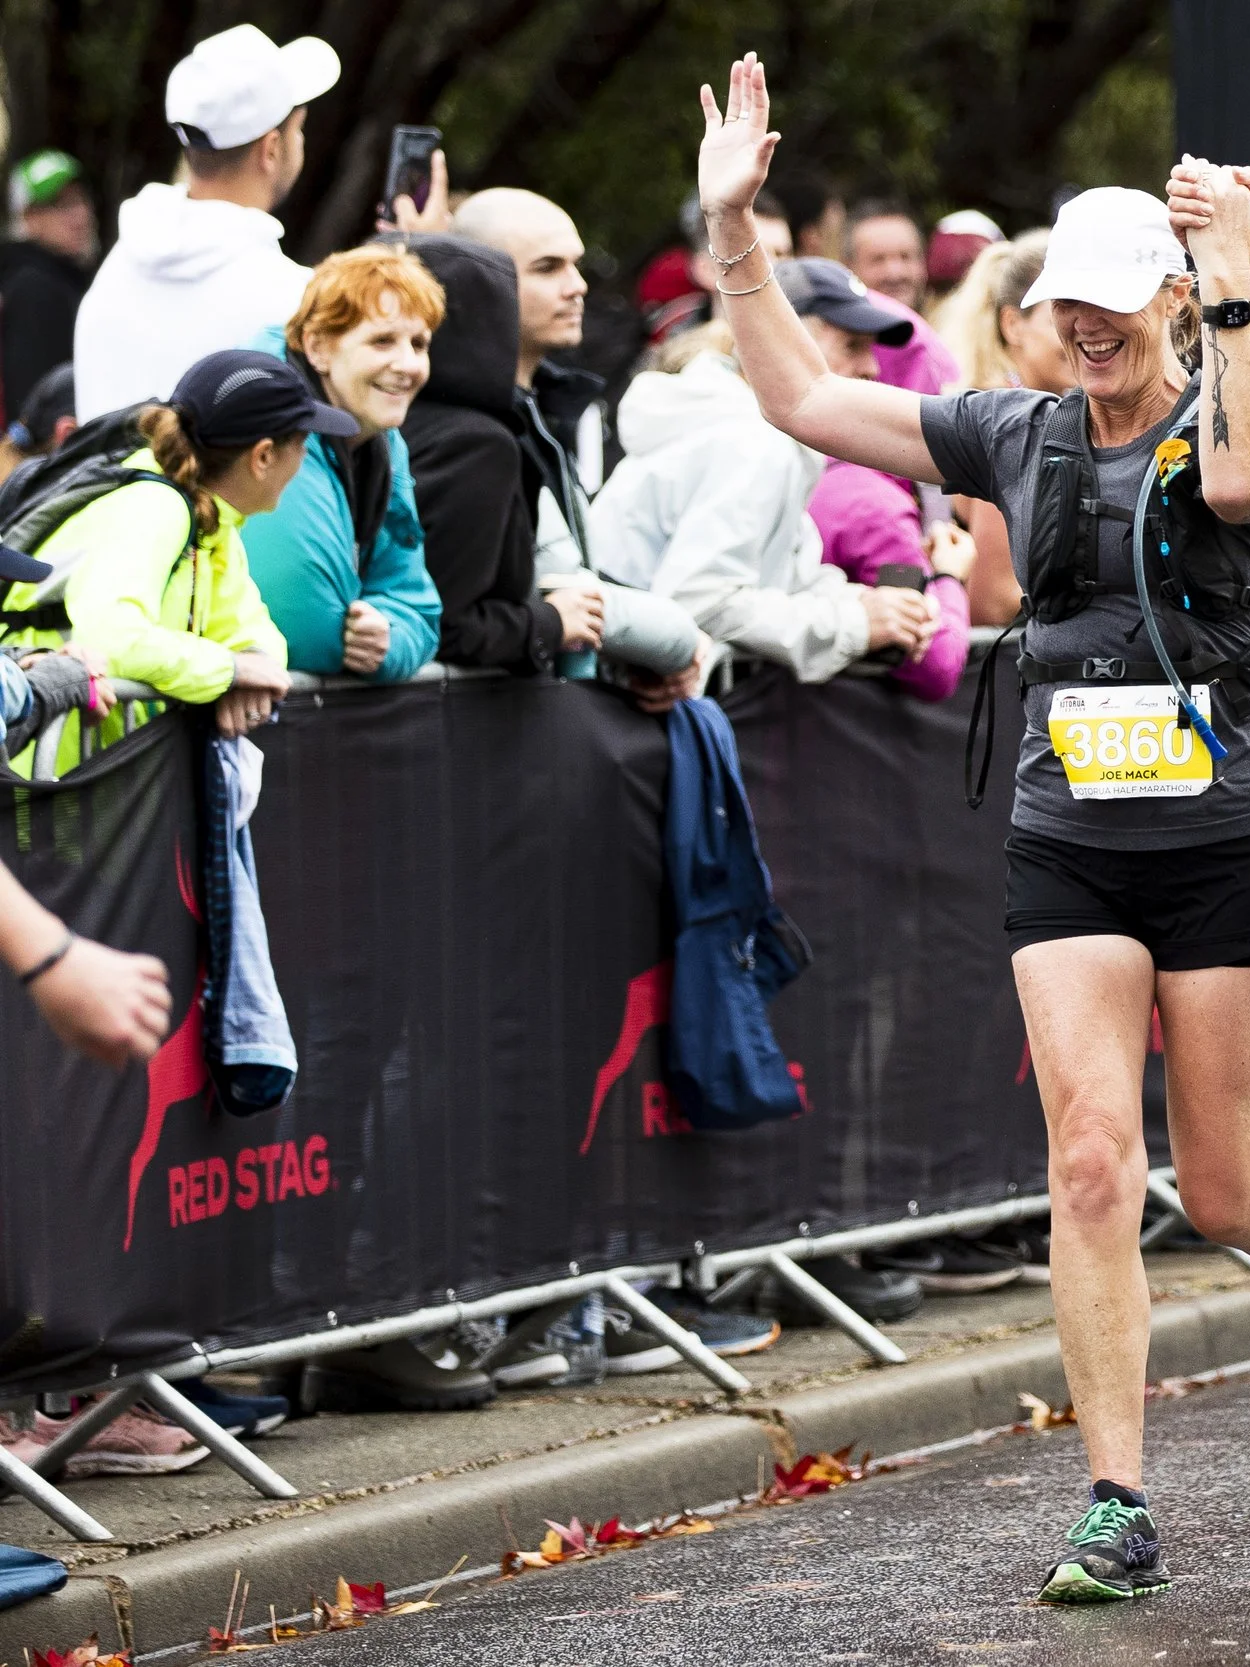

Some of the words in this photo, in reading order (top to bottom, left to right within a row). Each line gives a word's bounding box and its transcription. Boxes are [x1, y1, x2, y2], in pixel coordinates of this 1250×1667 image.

[1168, 696, 1198, 706] NT
[1065, 719, 1194, 769] 3860
[1100, 771, 1122, 780] JOE
[1125, 770, 1158, 780] MACK
[1073, 786, 1112, 796] ROTORUA
[1113, 786, 1137, 794] HALF
[1139, 784, 1193, 793] MARATHON
[168, 1156, 230, 1228] RED
[235, 1135, 331, 1210] STAG
